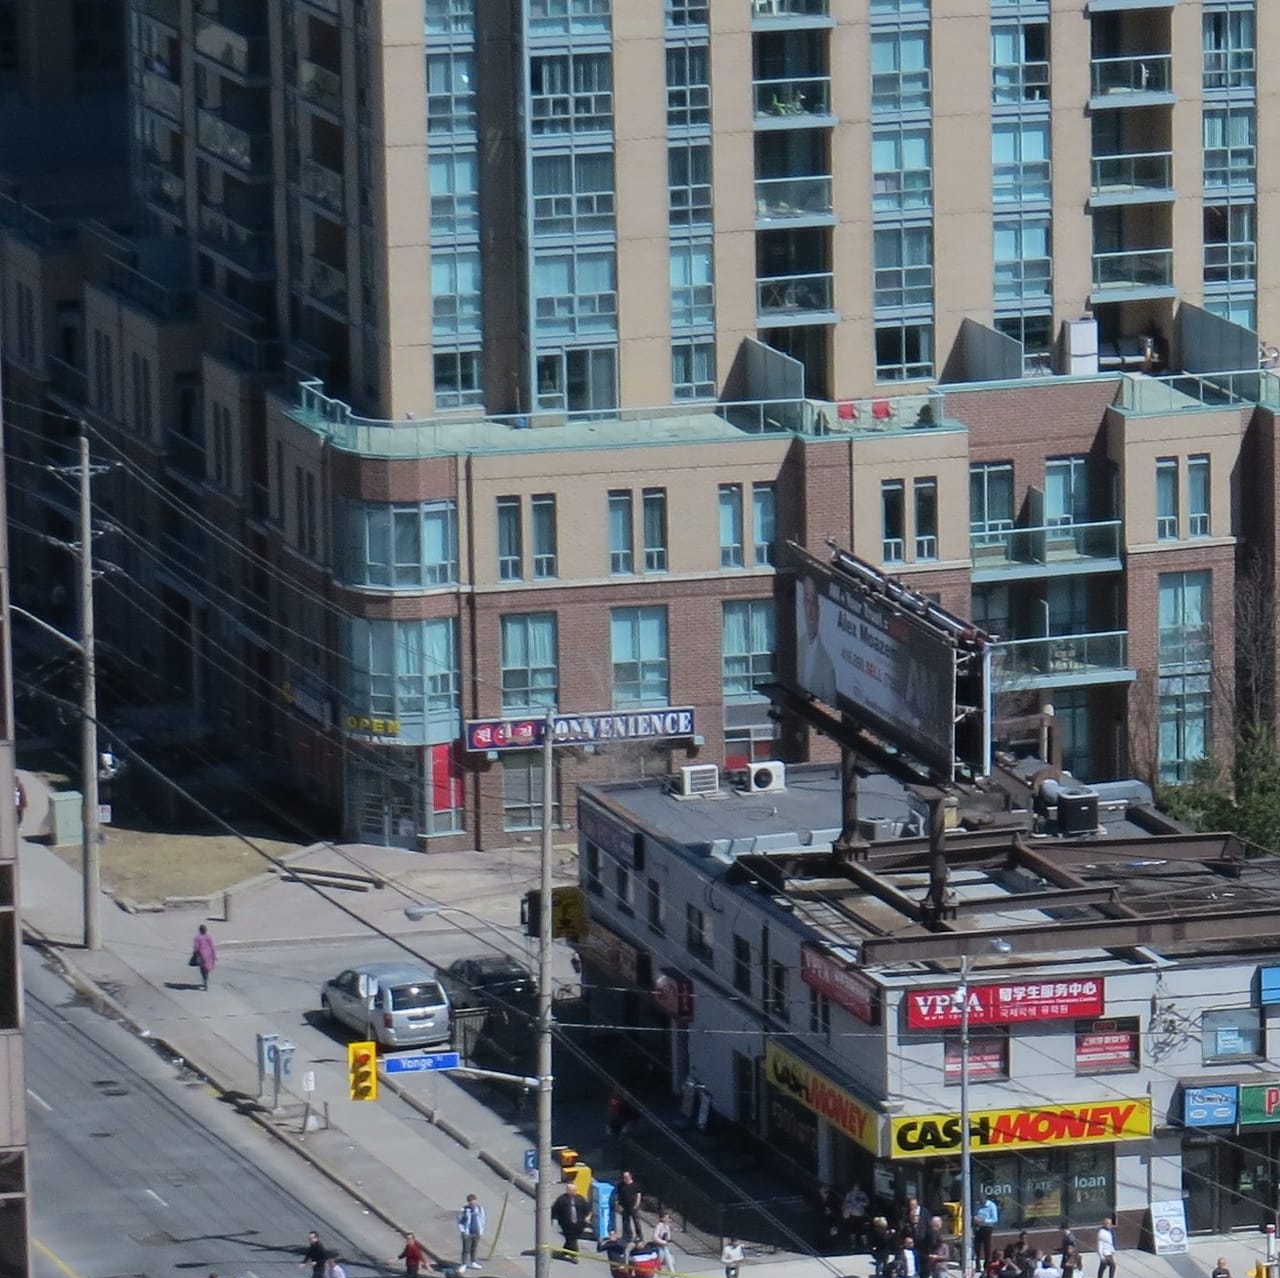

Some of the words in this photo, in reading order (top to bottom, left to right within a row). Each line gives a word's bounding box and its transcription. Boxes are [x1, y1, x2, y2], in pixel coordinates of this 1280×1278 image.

[346, 714, 401, 734] OPEN
[541, 711, 692, 744] CONVENIENCE
[401, 1057, 434, 1070] Yonge
[1074, 1175, 1106, 1188] loan
